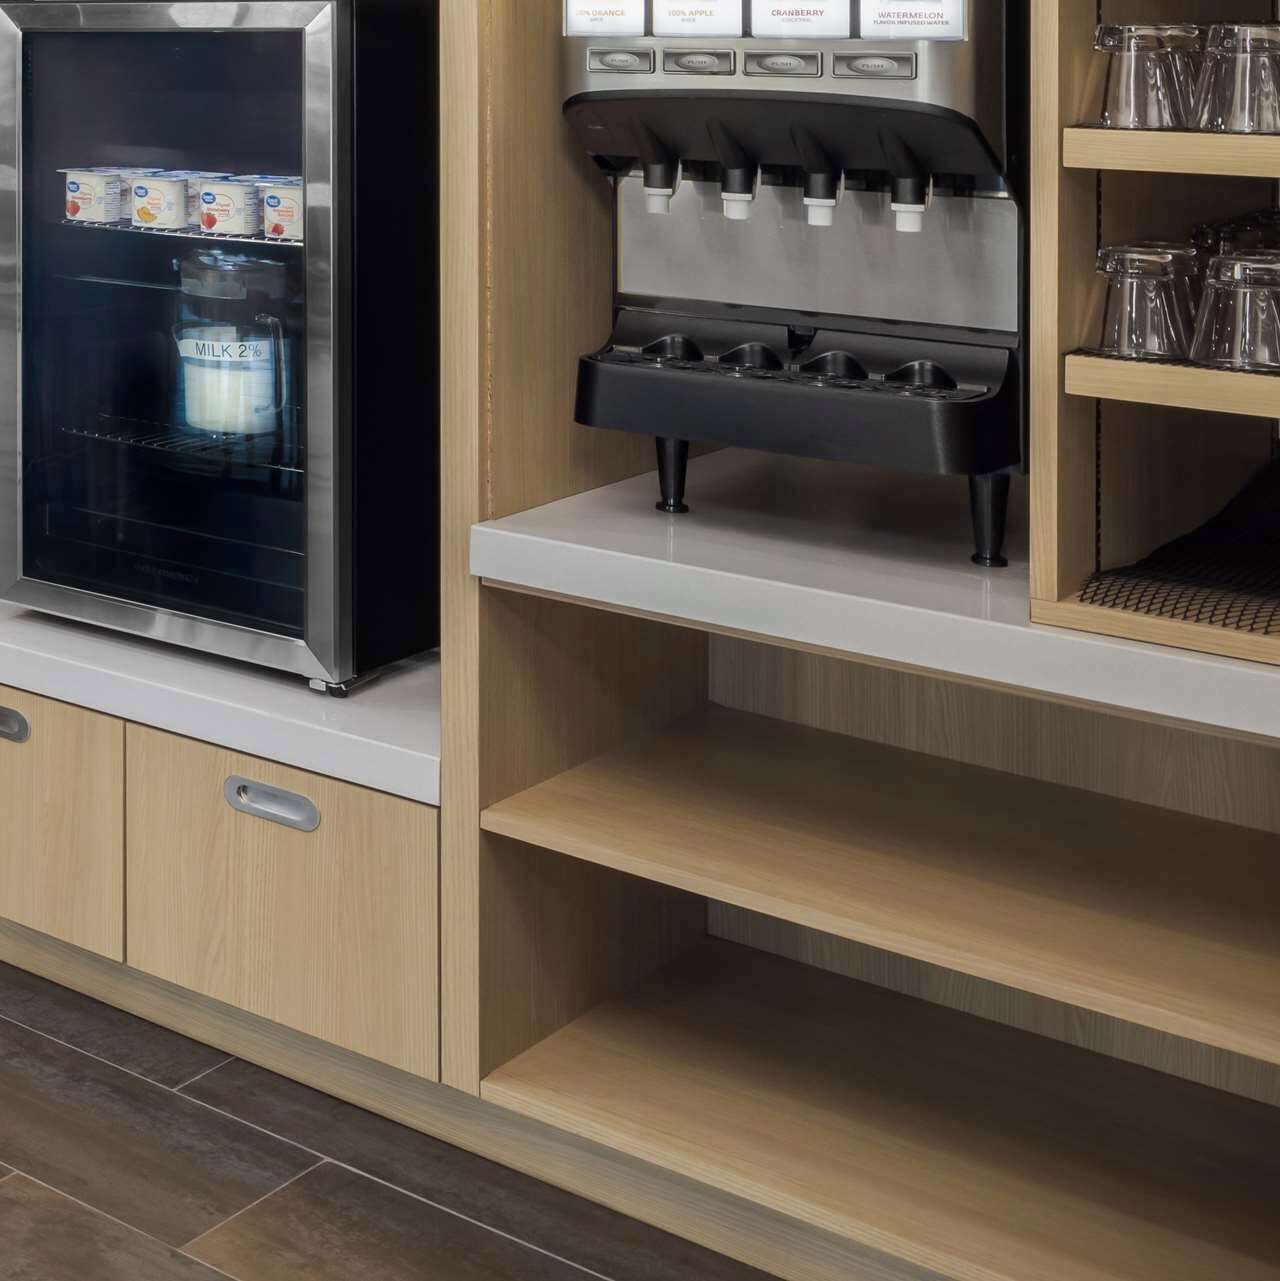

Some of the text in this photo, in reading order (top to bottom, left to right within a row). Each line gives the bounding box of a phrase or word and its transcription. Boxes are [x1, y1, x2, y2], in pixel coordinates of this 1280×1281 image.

[592, 9, 626, 17] ORANGE
[668, 9, 715, 17] 100% APPLE
[771, 9, 825, 17] CRANBERRY
[878, 11, 944, 19] WATERMELON
[195, 341, 264, 358] MILK 2%
